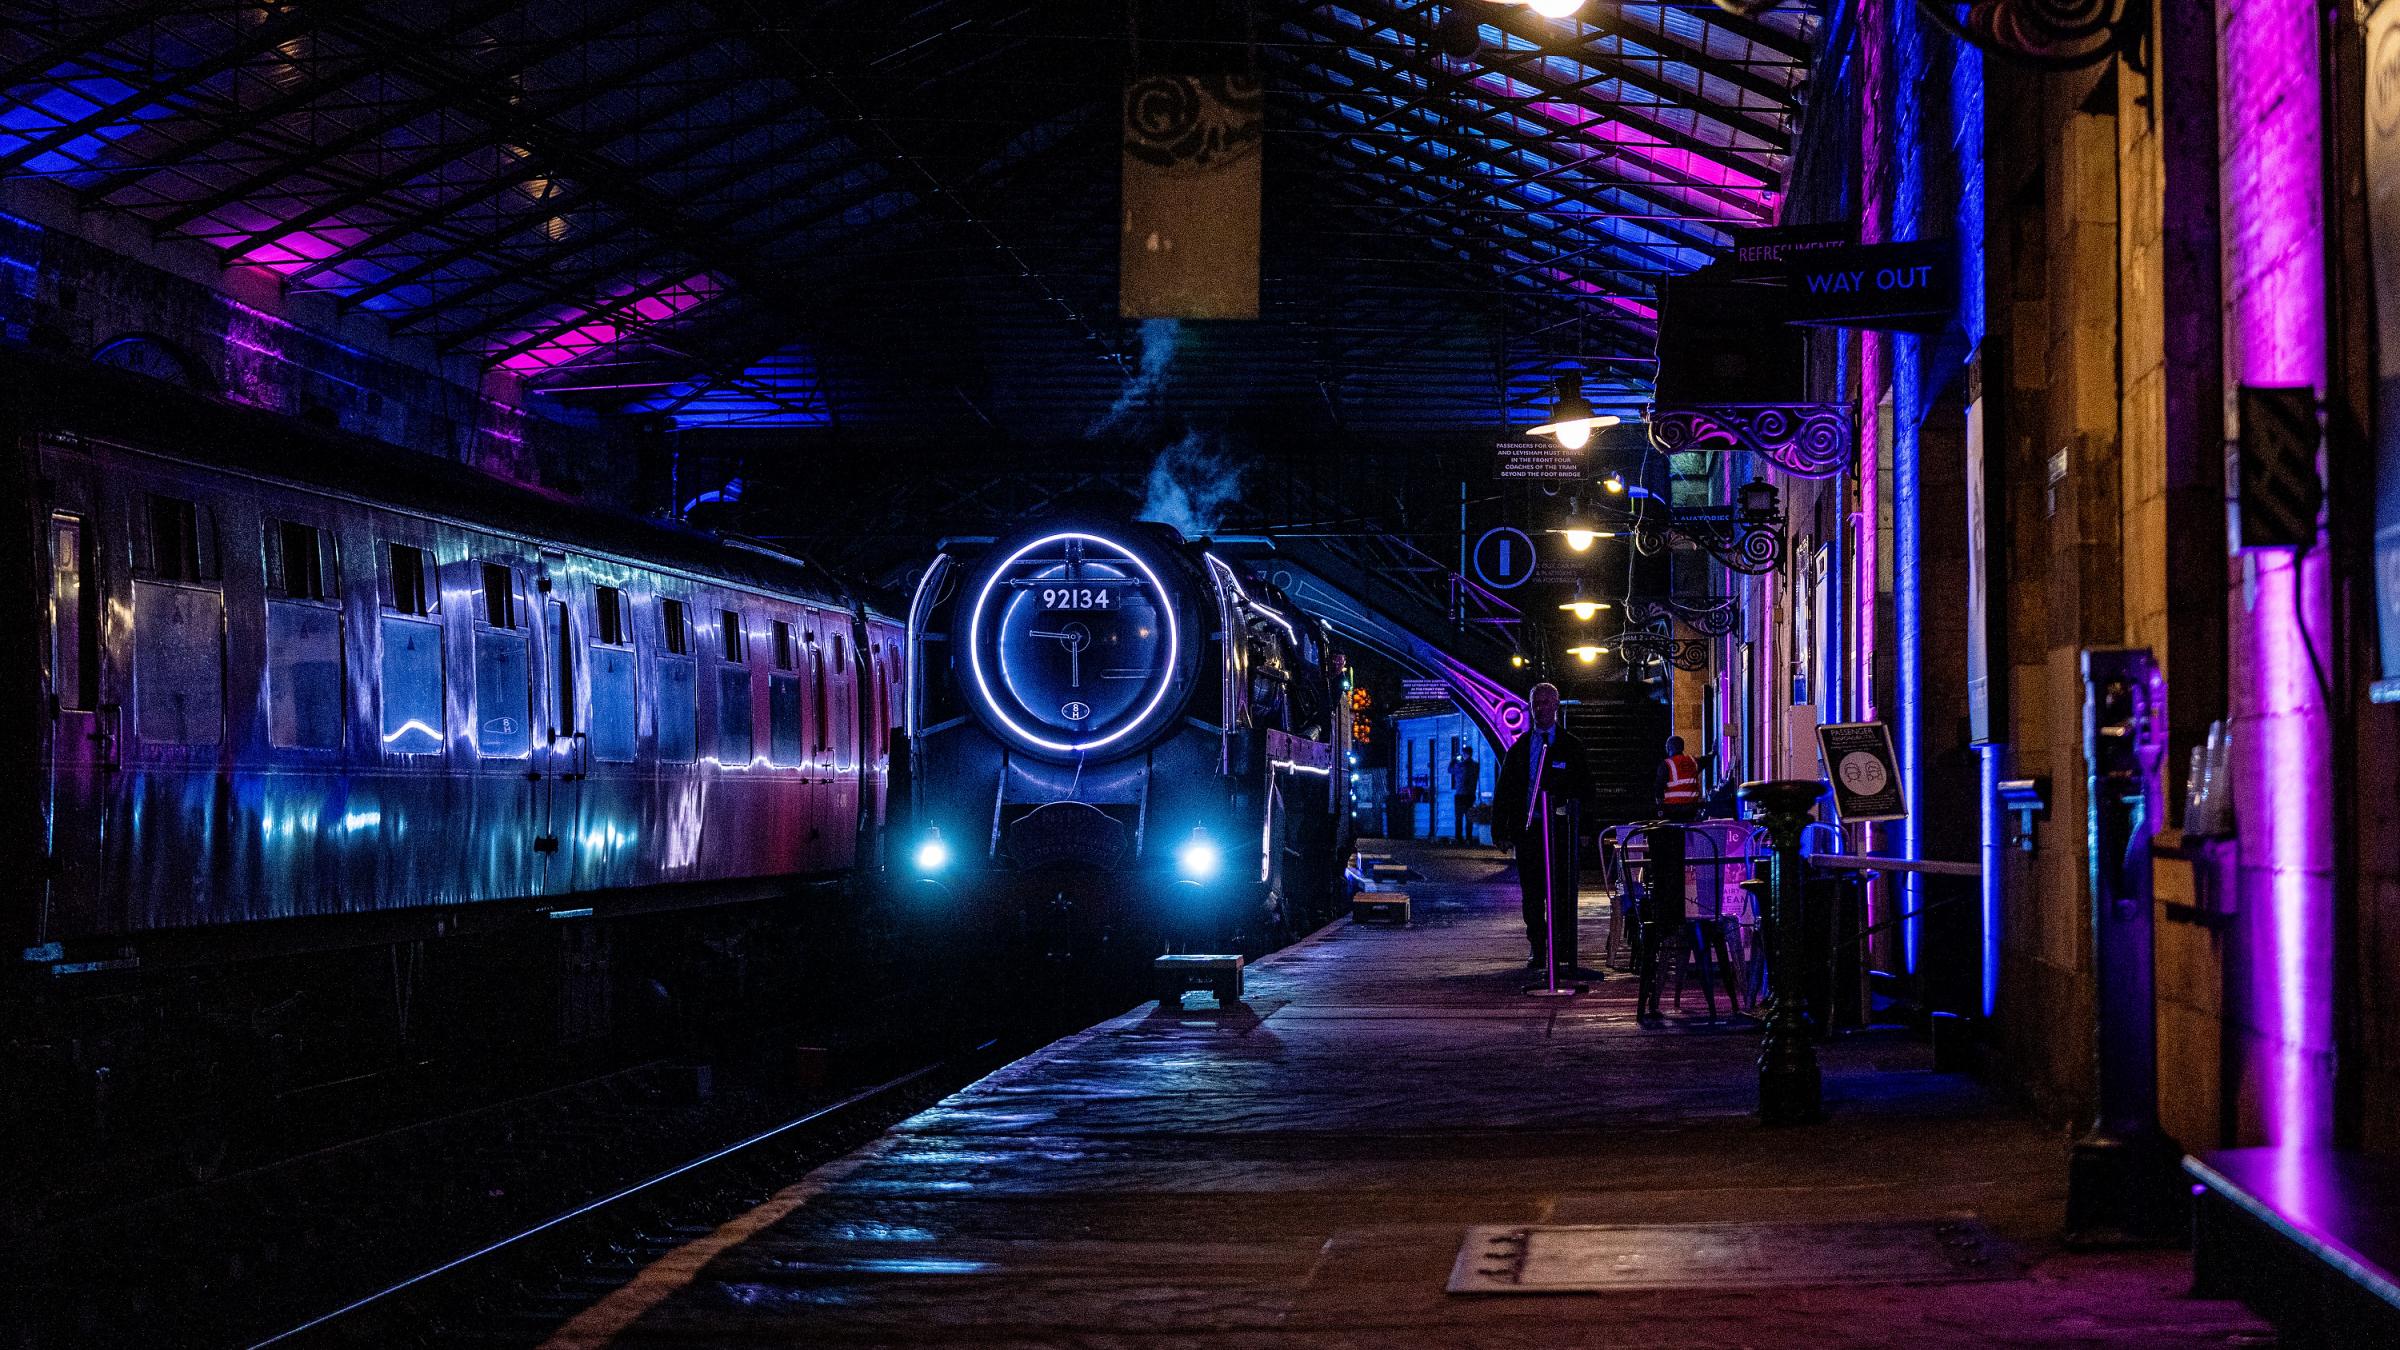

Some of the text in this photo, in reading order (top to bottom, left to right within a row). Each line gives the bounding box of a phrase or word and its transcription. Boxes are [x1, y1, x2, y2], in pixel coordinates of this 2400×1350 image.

[1806, 265, 1933, 295] WAY OUT
[1043, 588, 1110, 609] 92134
